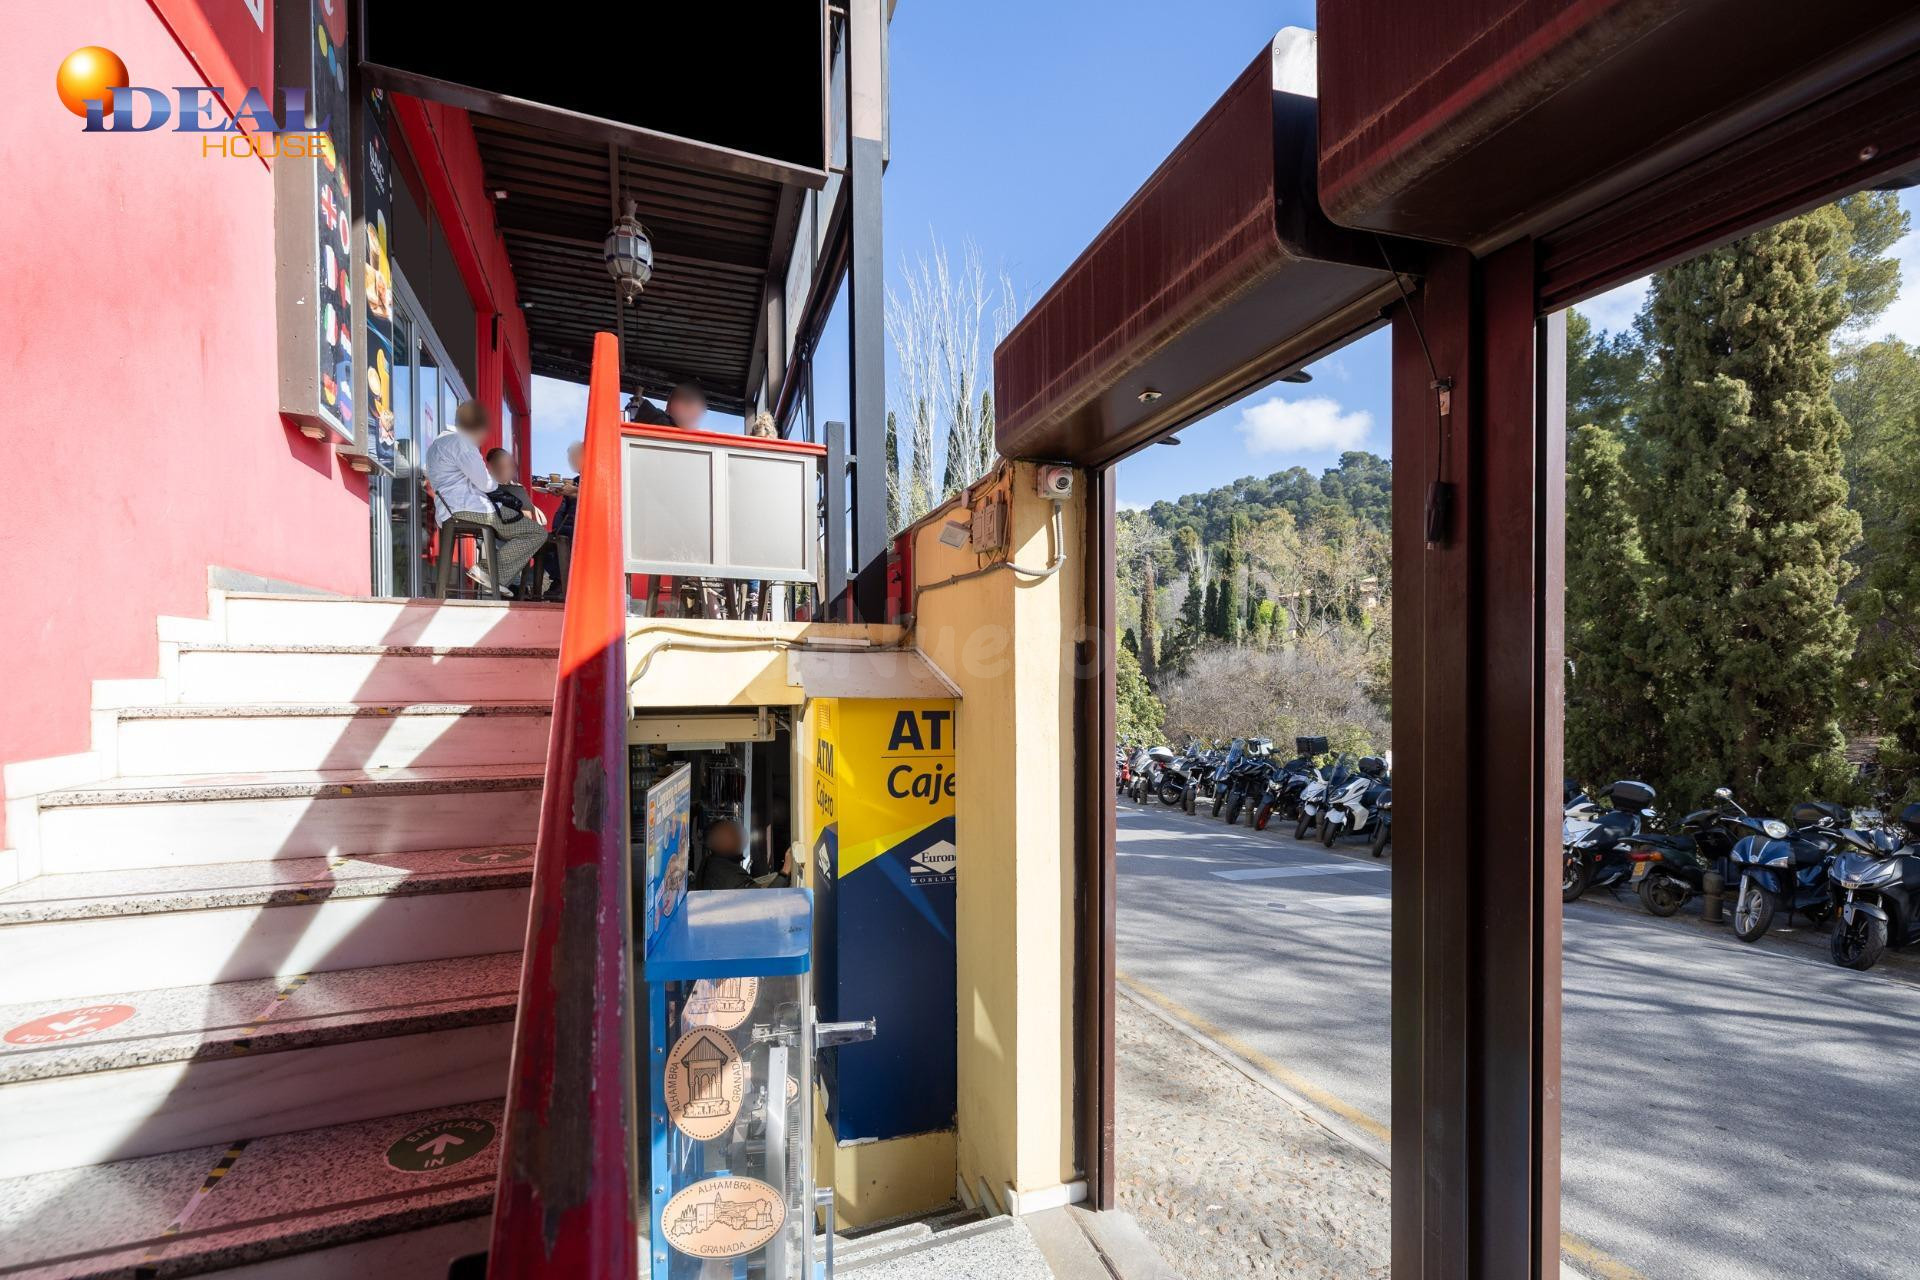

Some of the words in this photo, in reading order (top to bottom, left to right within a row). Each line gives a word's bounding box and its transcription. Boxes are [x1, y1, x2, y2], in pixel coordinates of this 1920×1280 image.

[888, 710, 956, 751] AT
[816, 738, 834, 777] ATM
[816, 779, 833, 817] Cajero
[921, 852, 956, 863] Euron
[667, 1062, 682, 1112] ALHAMBRA
[731, 1056, 744, 1103] GRANADA
[405, 1121, 486, 1143] ENTRADA
[424, 1157, 446, 1168] IN
[698, 1181, 751, 1195] ALHAMBRA
[700, 1241, 746, 1254] GRANADA
